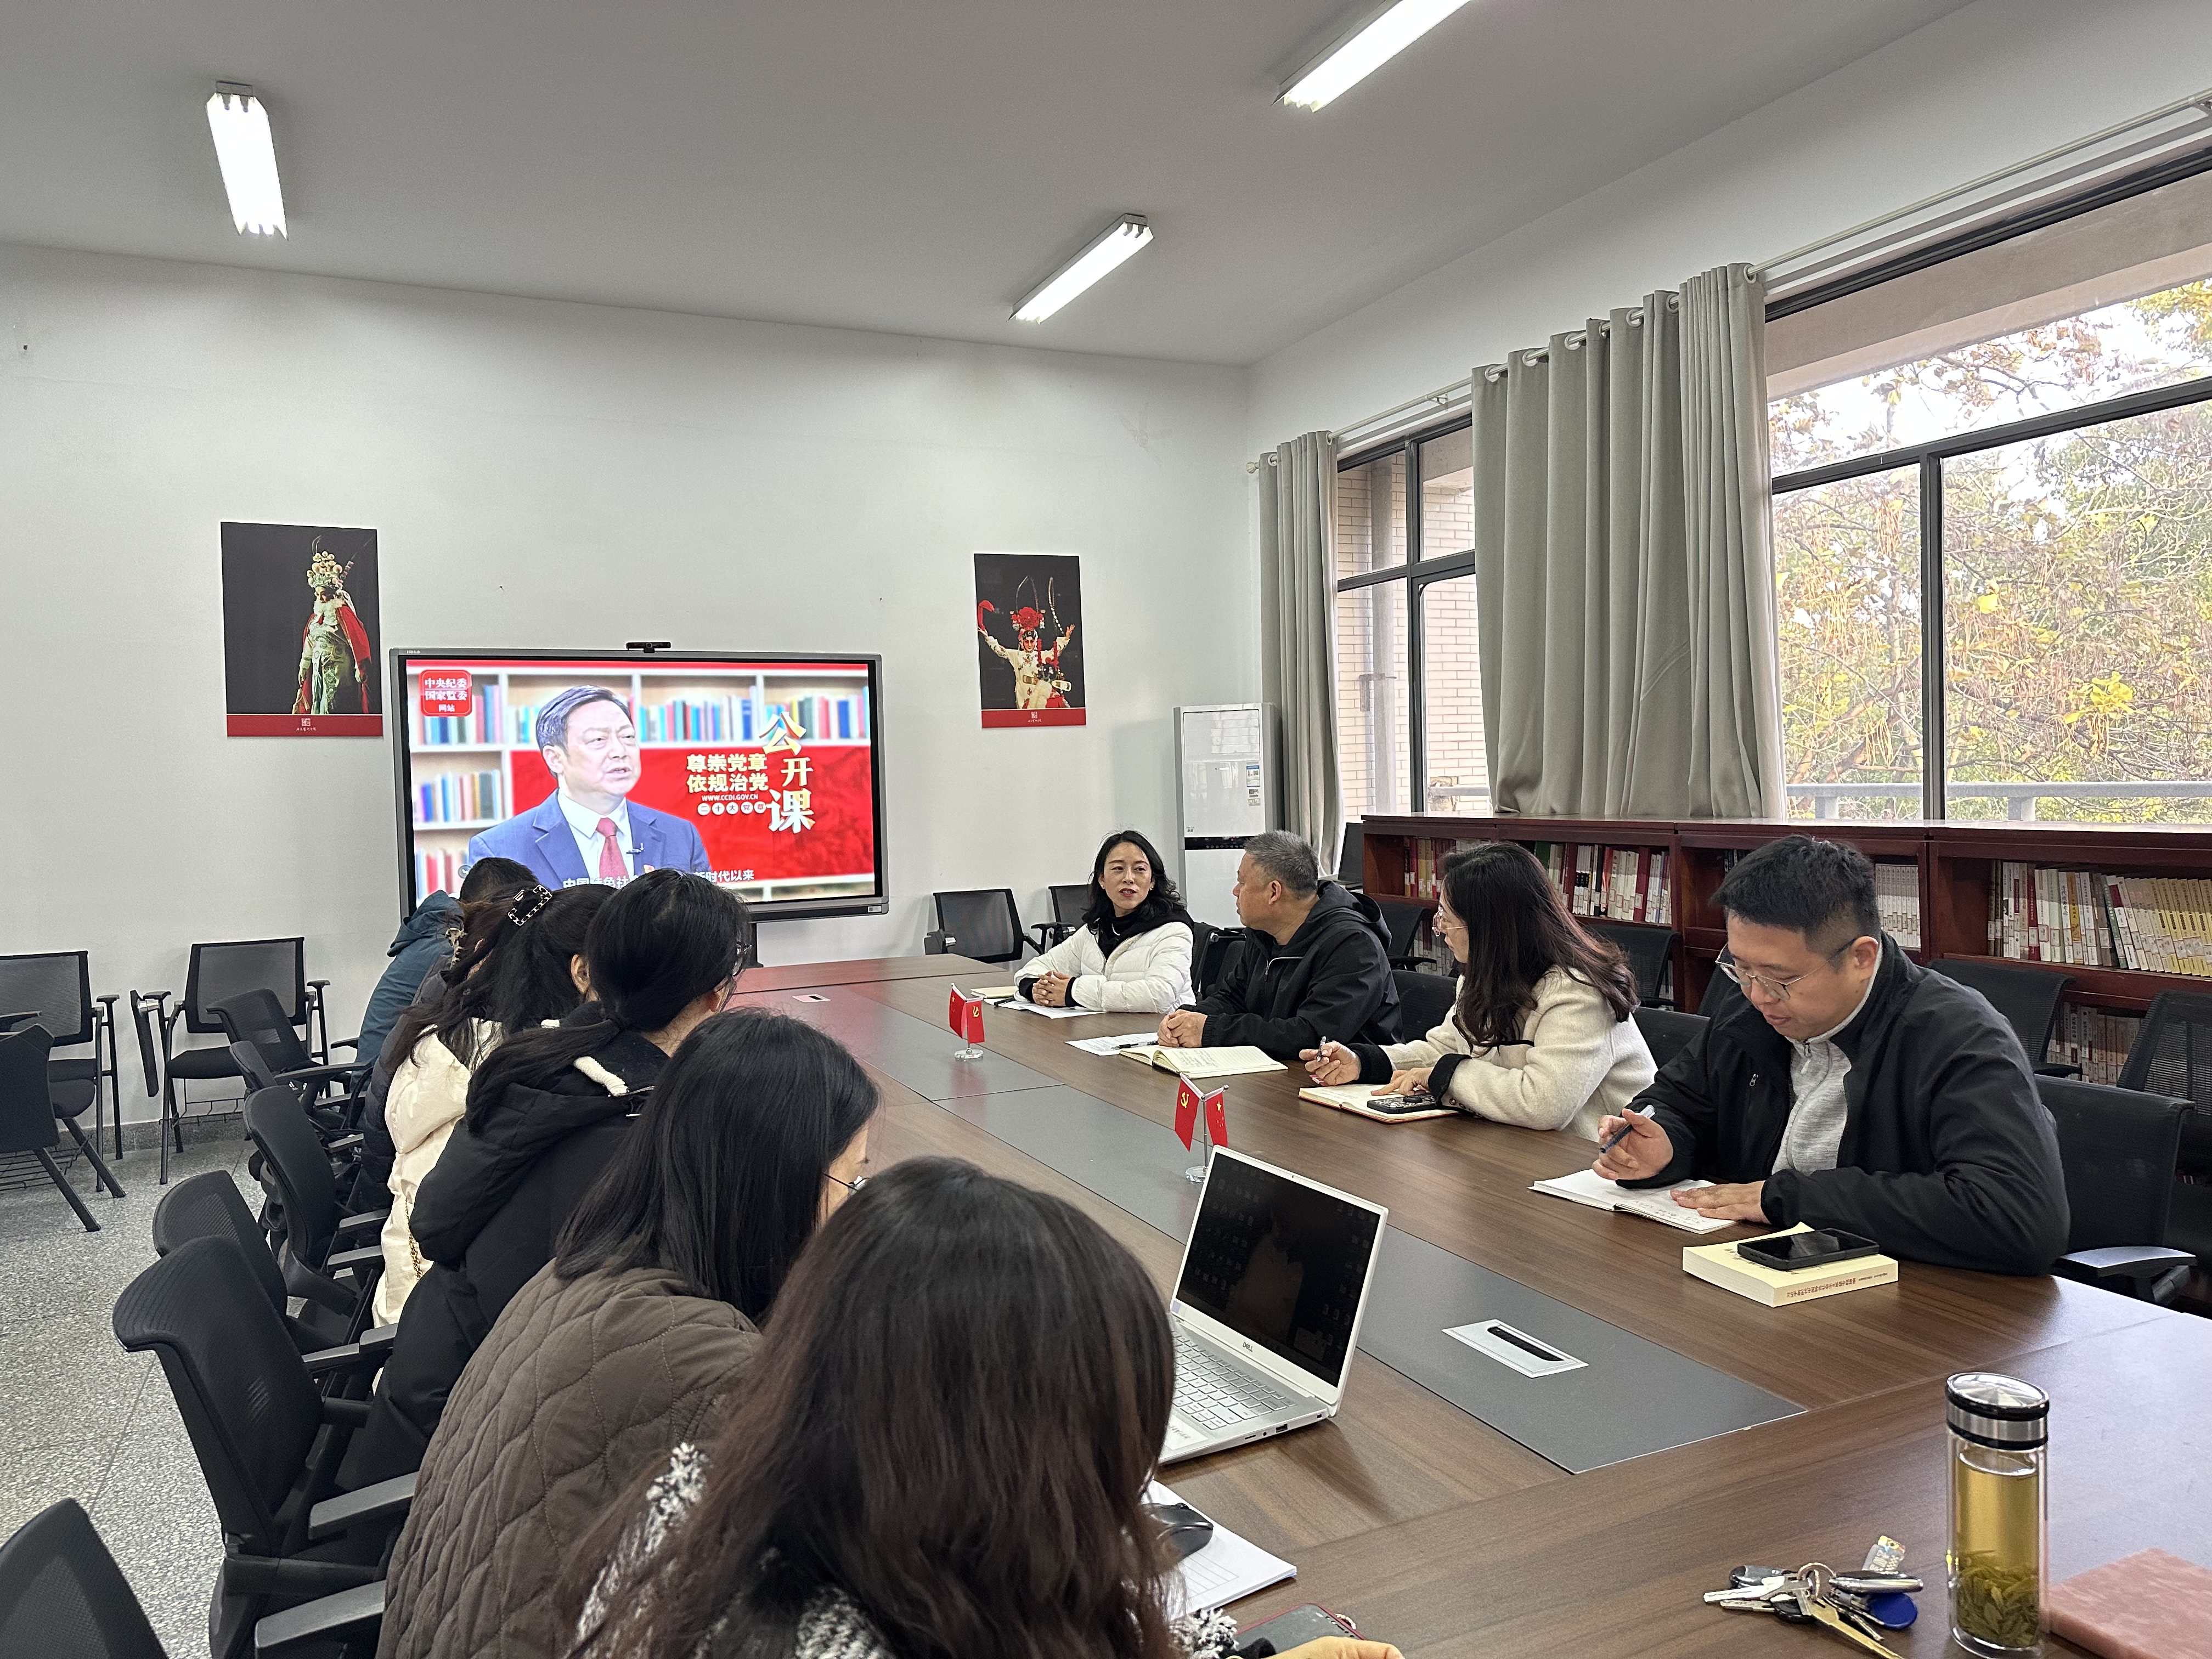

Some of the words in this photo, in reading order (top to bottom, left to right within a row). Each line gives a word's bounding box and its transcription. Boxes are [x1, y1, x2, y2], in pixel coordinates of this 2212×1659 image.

[425, 678, 467, 688] 中央纪委
[425, 690, 467, 701] 国家监委
[438, 704, 455, 712] 网站
[687, 753, 768, 772] 尊崇党章
[759, 712, 816, 834] 公开课
[687, 773, 769, 793] 依规治党
[1243, 1341, 1253, 1352] DELL
